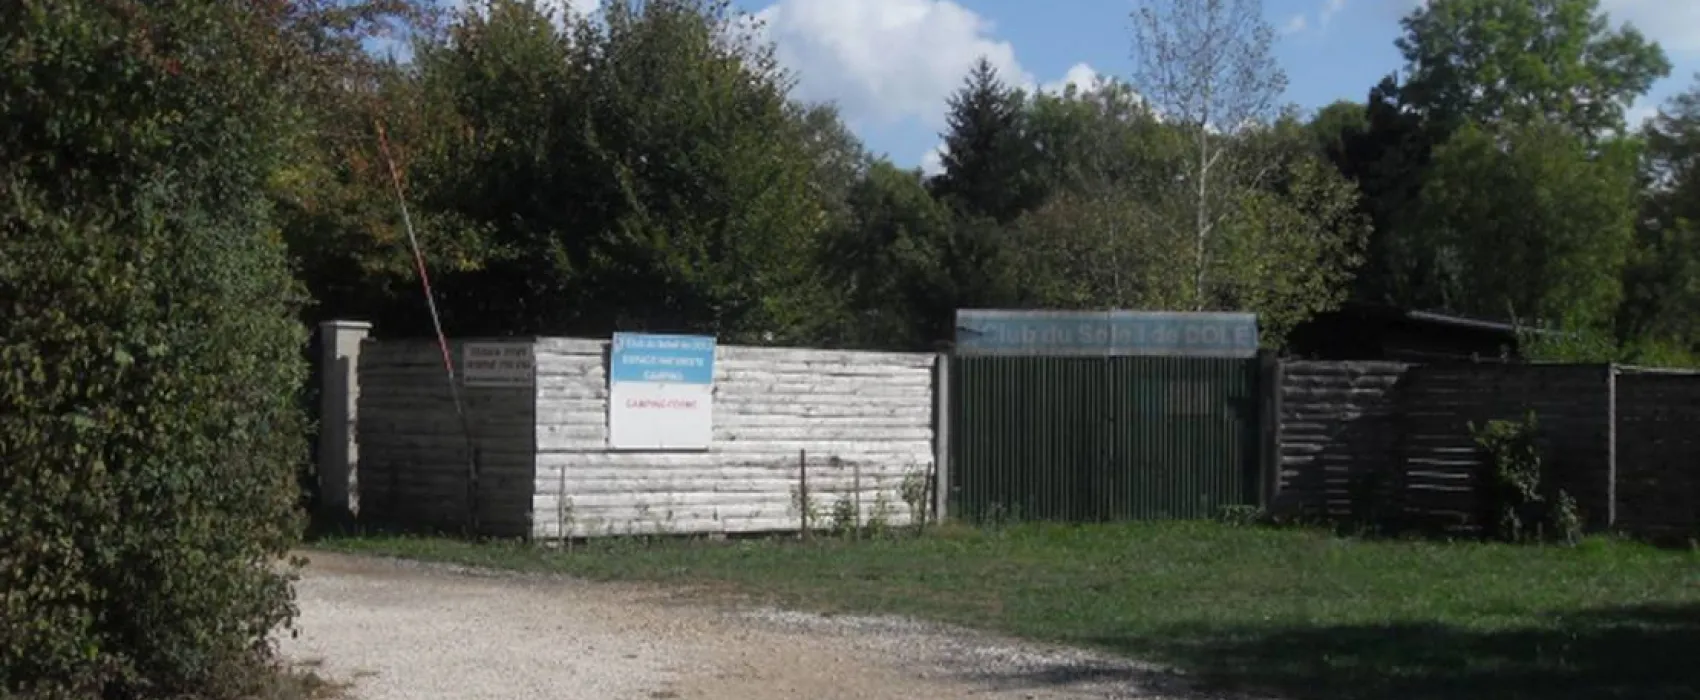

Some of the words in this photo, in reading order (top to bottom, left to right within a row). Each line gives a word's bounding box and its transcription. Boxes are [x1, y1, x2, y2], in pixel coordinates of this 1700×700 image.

[980, 321, 1037, 345] Club
[1042, 322, 1073, 345] du
[1151, 322, 1179, 345] de
[1184, 323, 1250, 347] DOLE
